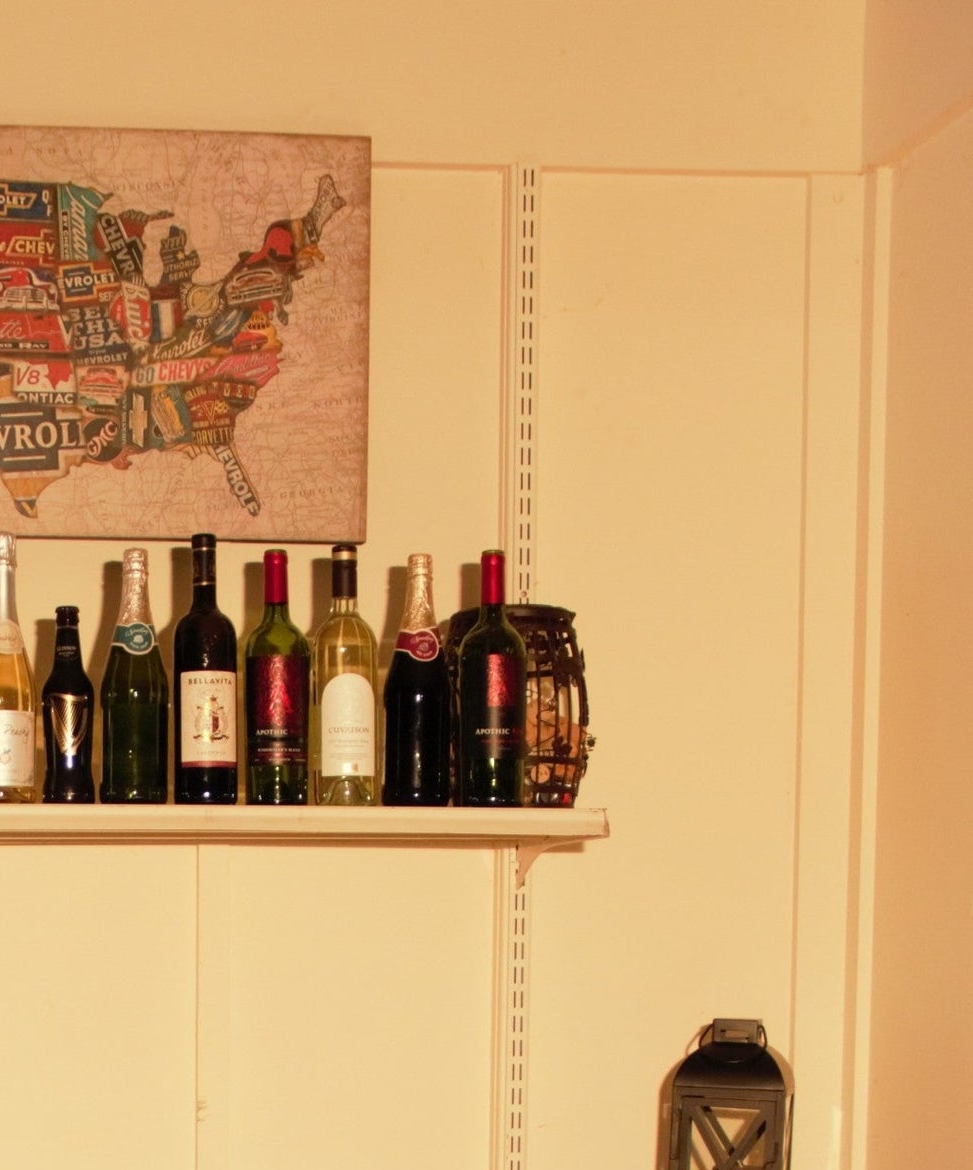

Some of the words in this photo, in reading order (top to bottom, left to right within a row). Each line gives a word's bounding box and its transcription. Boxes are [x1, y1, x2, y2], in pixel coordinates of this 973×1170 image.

[188, 677, 232, 686] BELLAVITA
[255, 728, 288, 736] APOTHIC
[475, 728, 510, 736] APOTHIC
